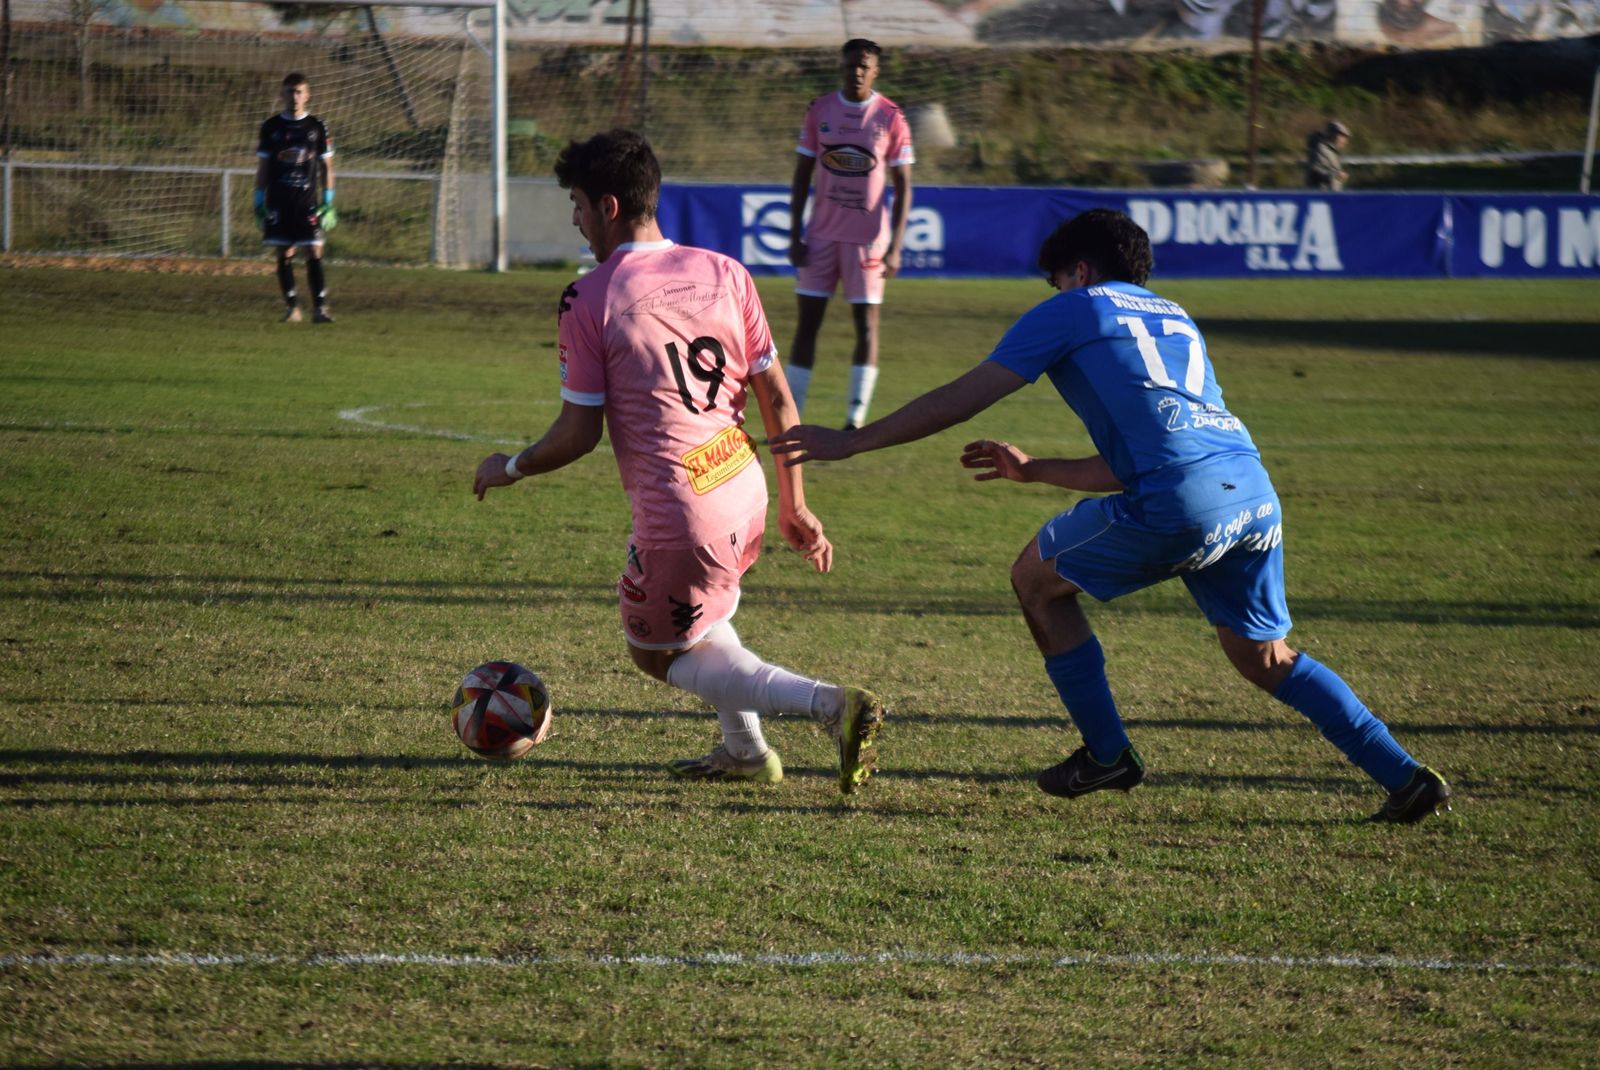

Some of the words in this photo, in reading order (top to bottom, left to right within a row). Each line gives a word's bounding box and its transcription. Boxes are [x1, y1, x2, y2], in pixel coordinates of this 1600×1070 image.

[664, 335, 727, 415] 19
[1116, 316, 1206, 397] 17
[687, 456, 709, 478] EL
